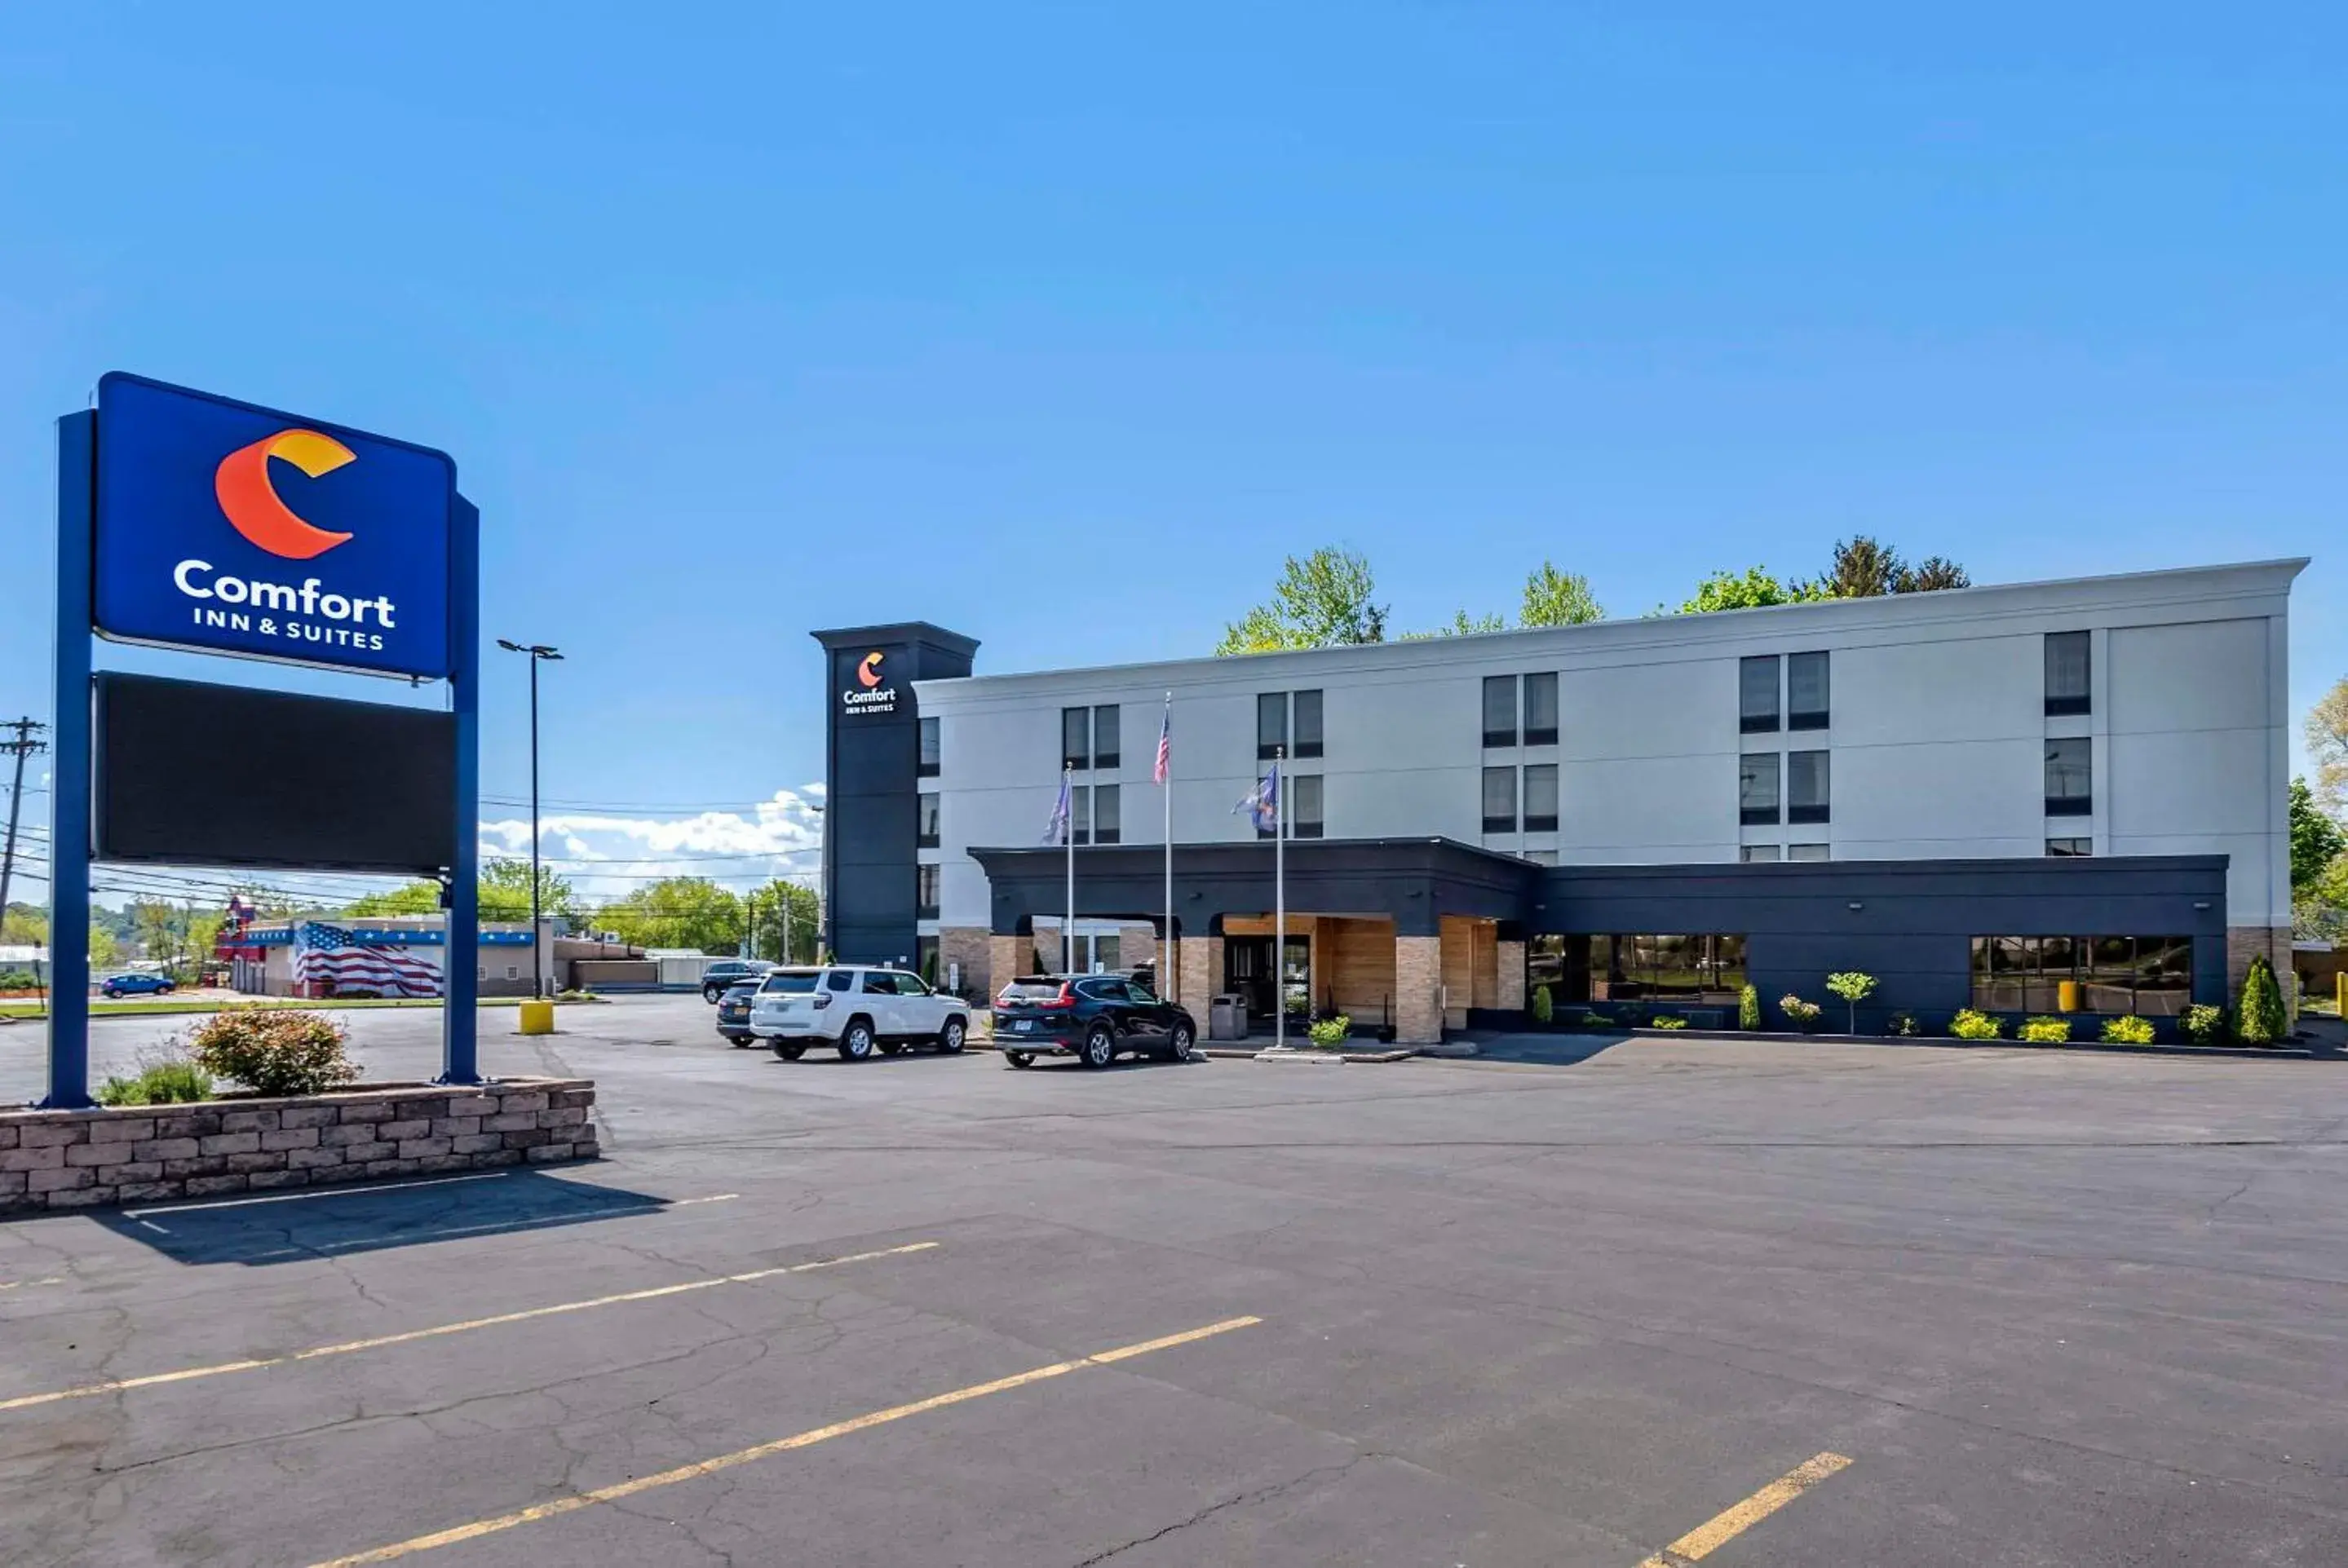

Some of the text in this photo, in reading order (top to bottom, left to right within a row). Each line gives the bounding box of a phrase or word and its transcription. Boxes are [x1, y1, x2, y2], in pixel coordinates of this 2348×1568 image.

[174, 559, 396, 629] Comfort
[193, 608, 384, 651] INN & SUITES
[843, 687, 896, 704] Comfort
